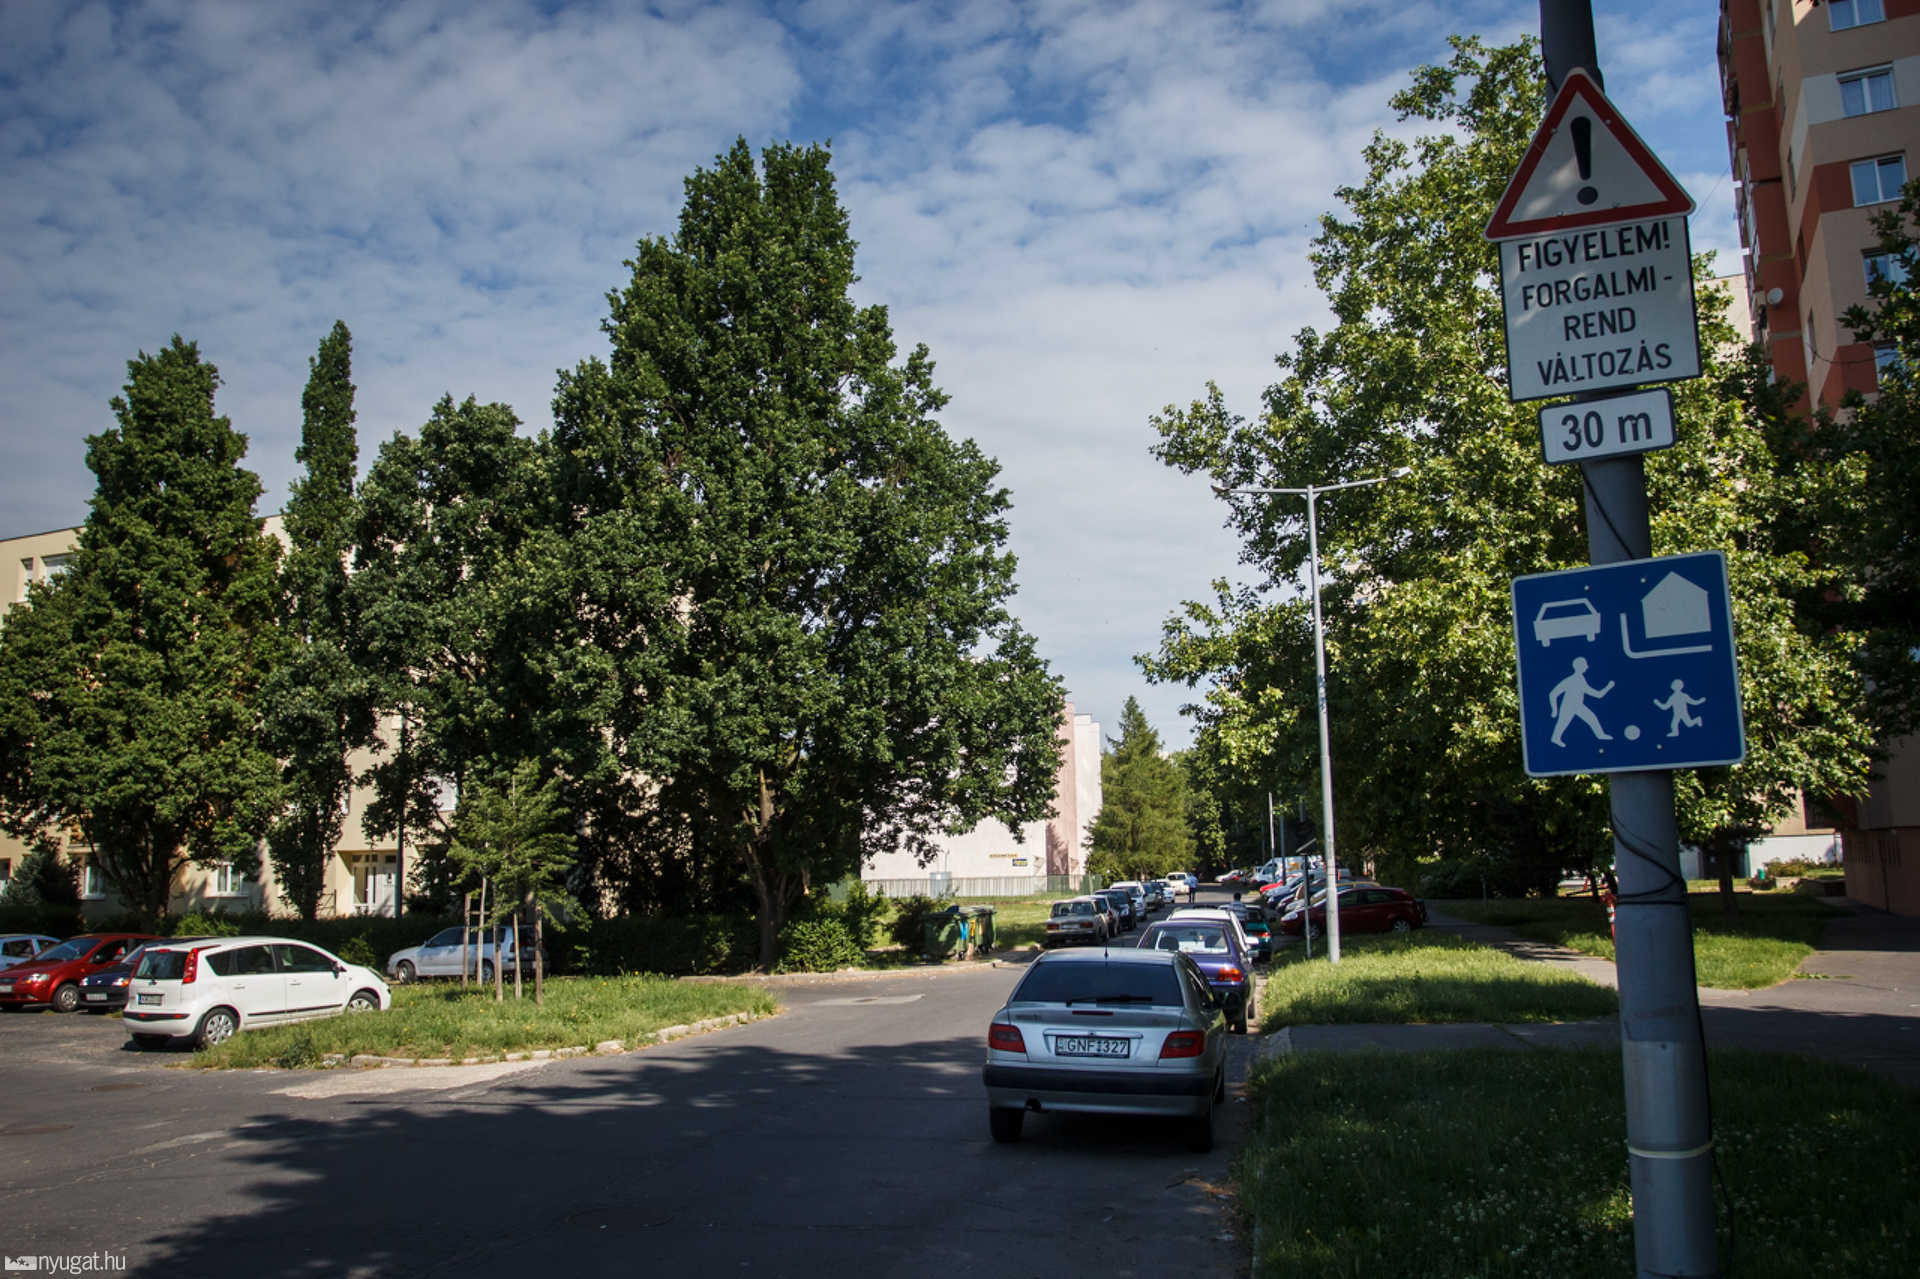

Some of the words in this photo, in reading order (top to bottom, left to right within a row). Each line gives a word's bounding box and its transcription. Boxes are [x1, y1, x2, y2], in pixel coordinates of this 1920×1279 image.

[1518, 222, 1670, 270] FIGYELEM!
[1564, 307, 1636, 341] REND
[1537, 339, 1672, 386] VÁLTOZÁS
[1561, 411, 1603, 451] 30
[1618, 411, 1652, 444] m
